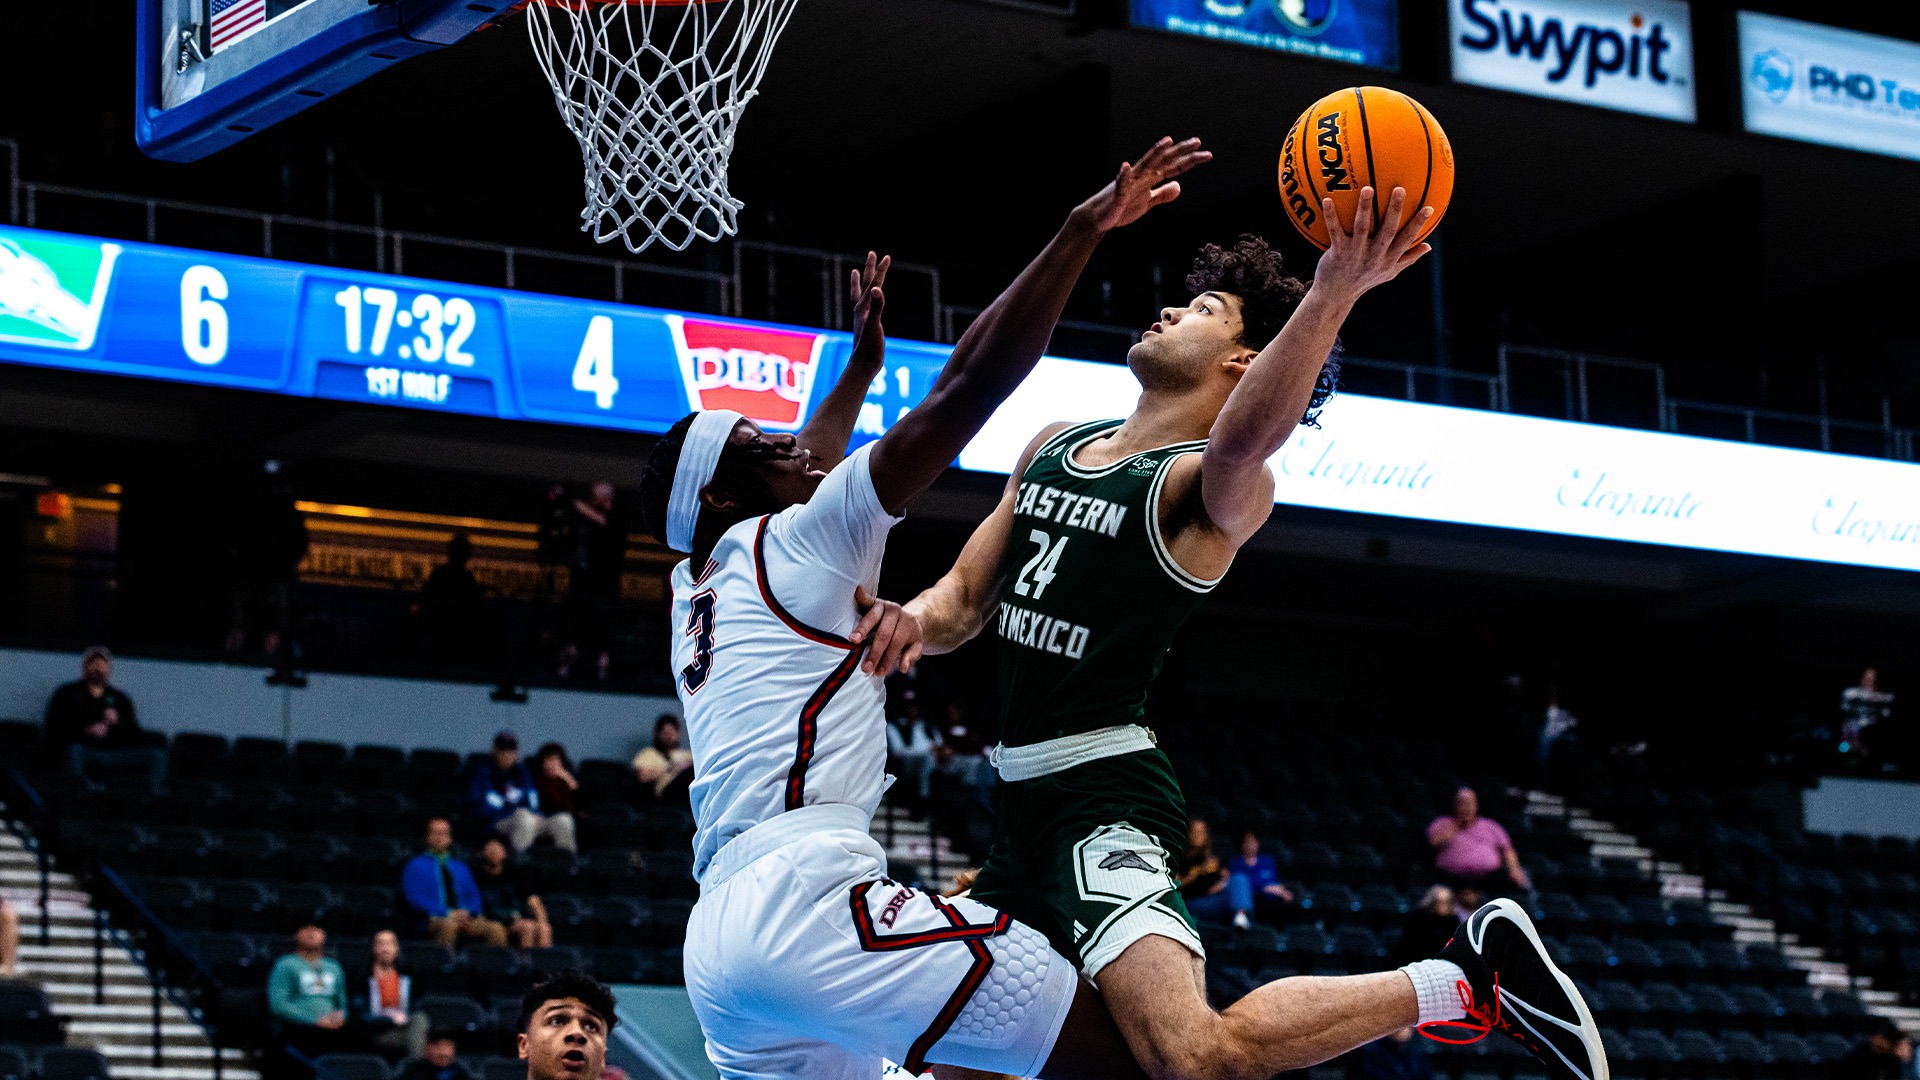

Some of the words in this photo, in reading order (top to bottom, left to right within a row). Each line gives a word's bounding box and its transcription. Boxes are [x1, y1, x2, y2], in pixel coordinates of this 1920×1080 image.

[1461, 0, 1669, 90] Swypit
[1316, 110, 1353, 193] NCAA
[179, 264, 230, 366] 6
[334, 284, 477, 368] 17:32
[571, 315, 620, 410] 4
[692, 345, 809, 405] DBU
[1281, 432, 1442, 490] Elegante
[1557, 465, 1705, 520] Elegante
[1013, 481, 1128, 540] EASTERN
[1013, 527, 1070, 601] 24
[680, 586, 718, 697] 3
[1006, 604, 1091, 660] MEXICO
[878, 885, 916, 931] DBU
